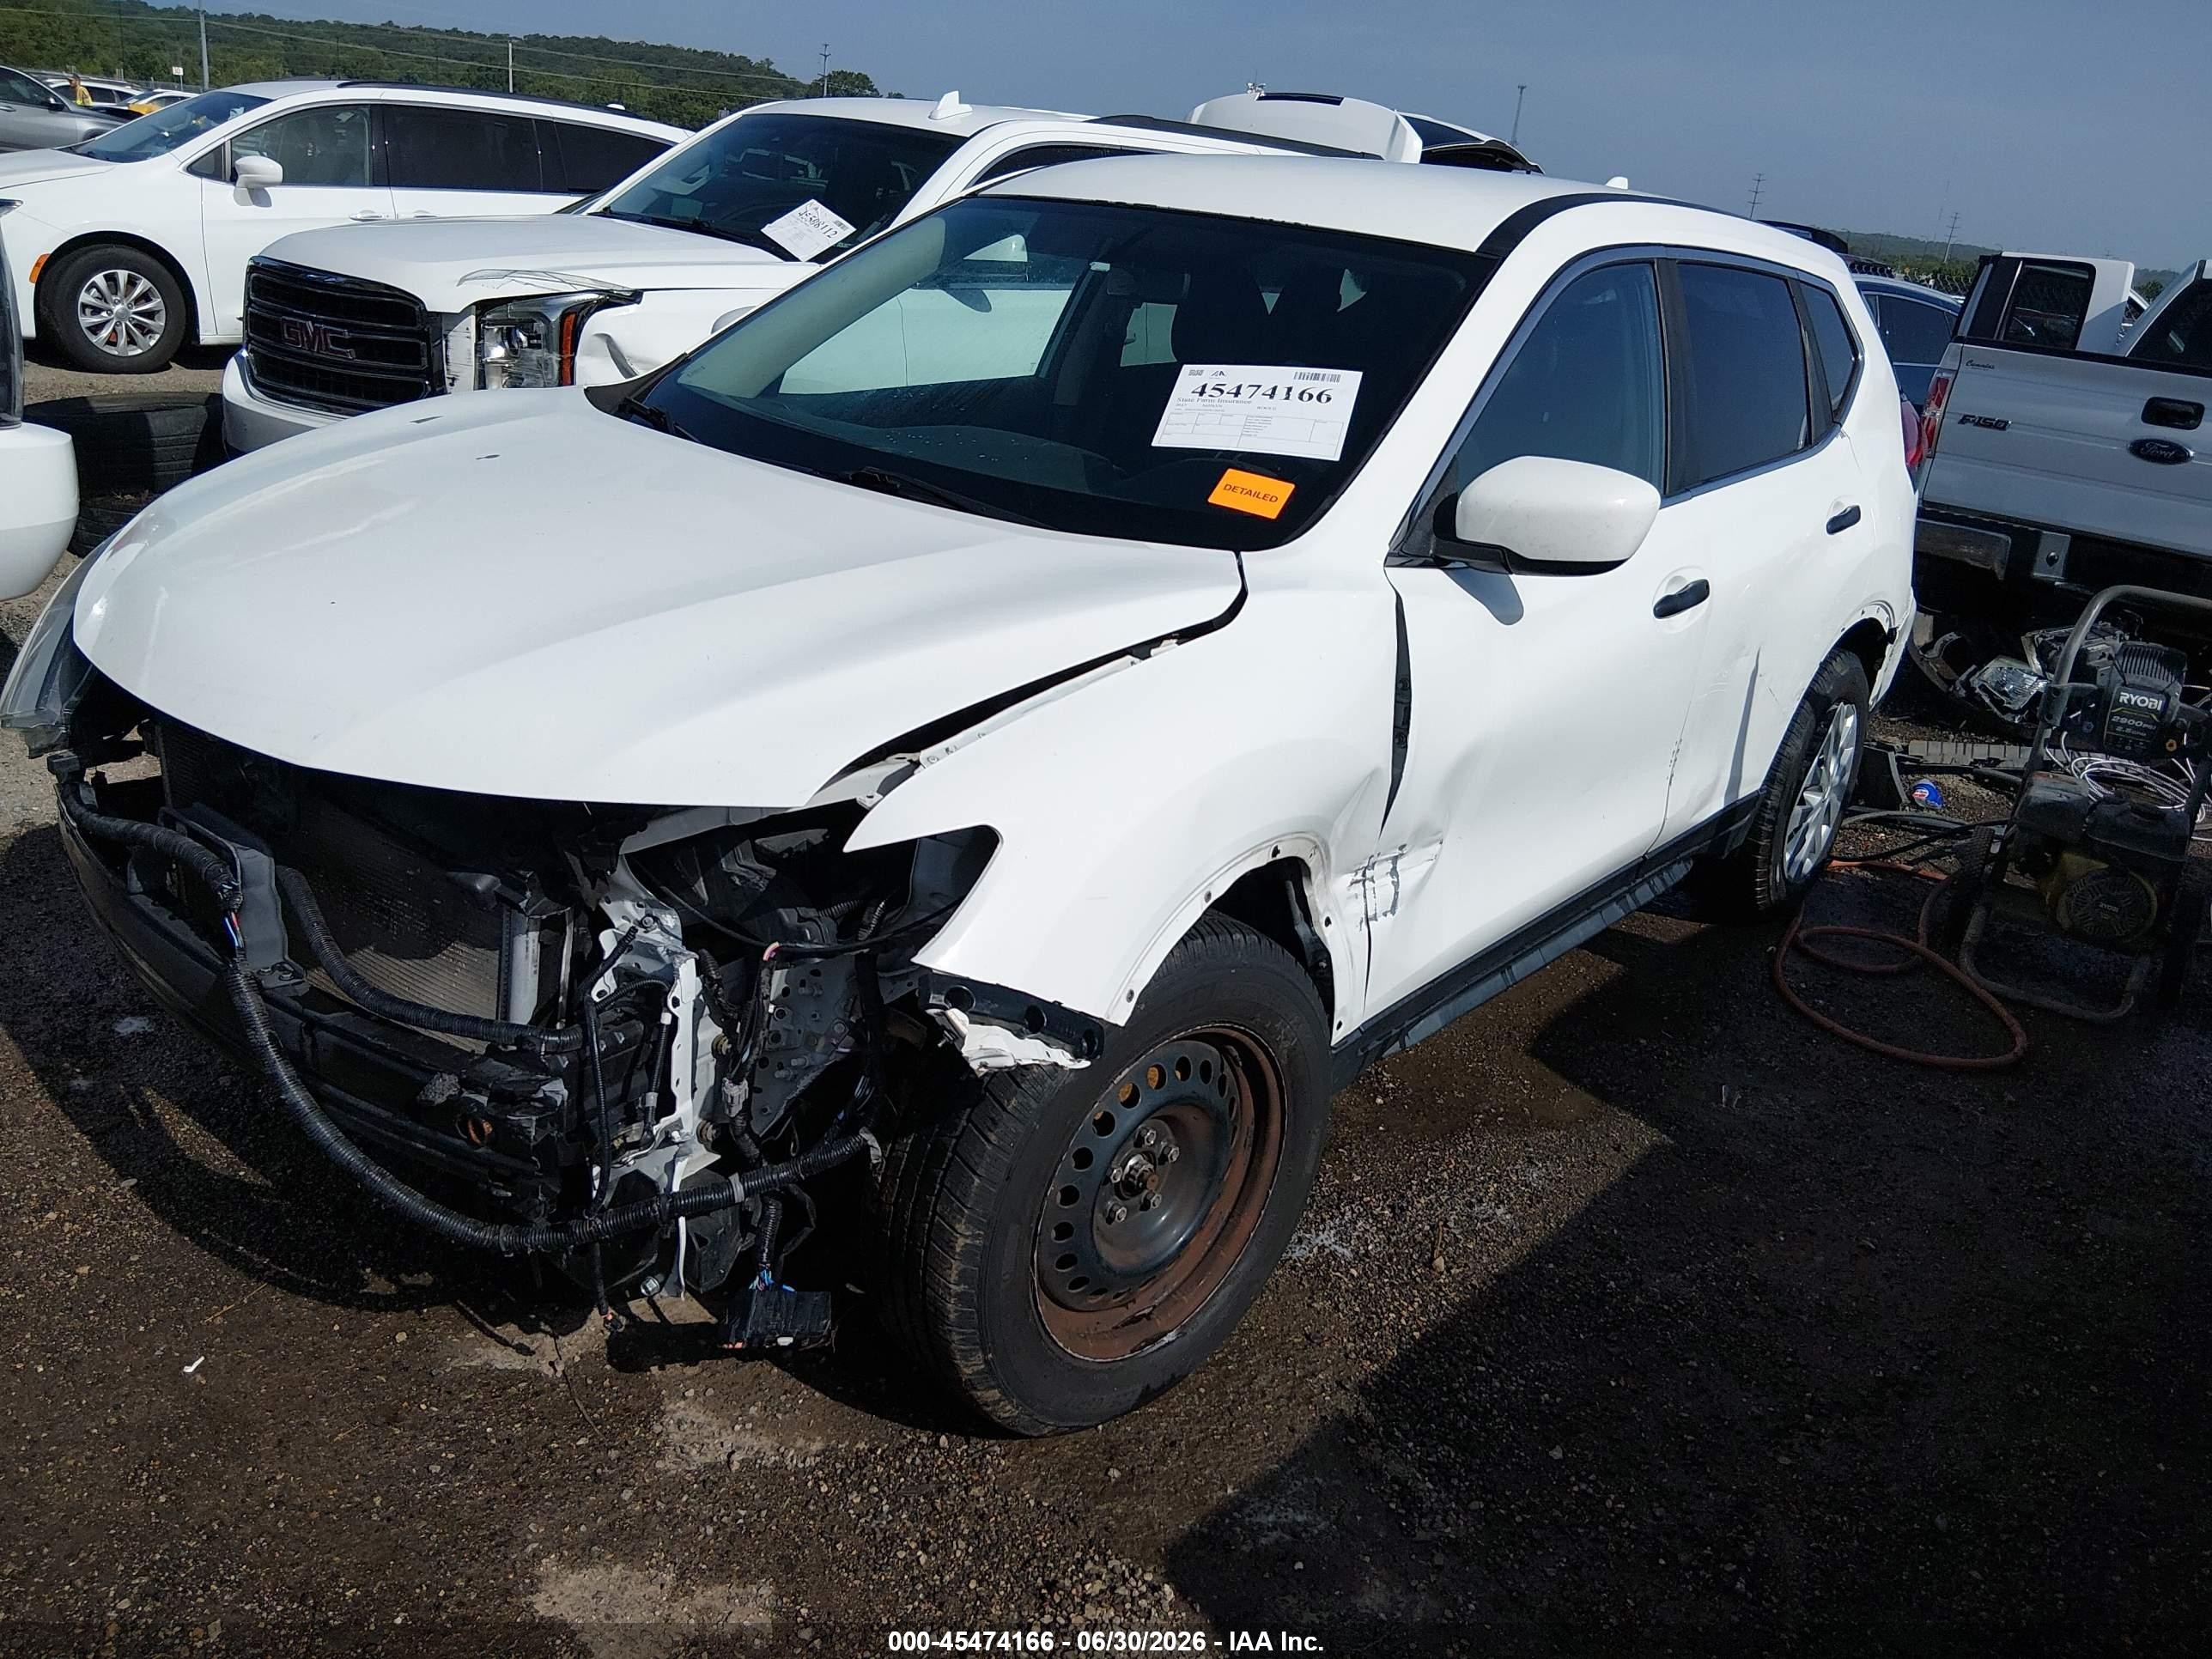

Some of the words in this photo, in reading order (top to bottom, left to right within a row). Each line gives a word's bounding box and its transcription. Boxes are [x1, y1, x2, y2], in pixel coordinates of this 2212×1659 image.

[281, 316, 356, 358] GMC
[1191, 382, 1334, 404] 45474166
[2140, 441, 2178, 459] Ford
[1223, 483, 1279, 503] DETAILED
[2118, 691, 2163, 711] RYOBI
